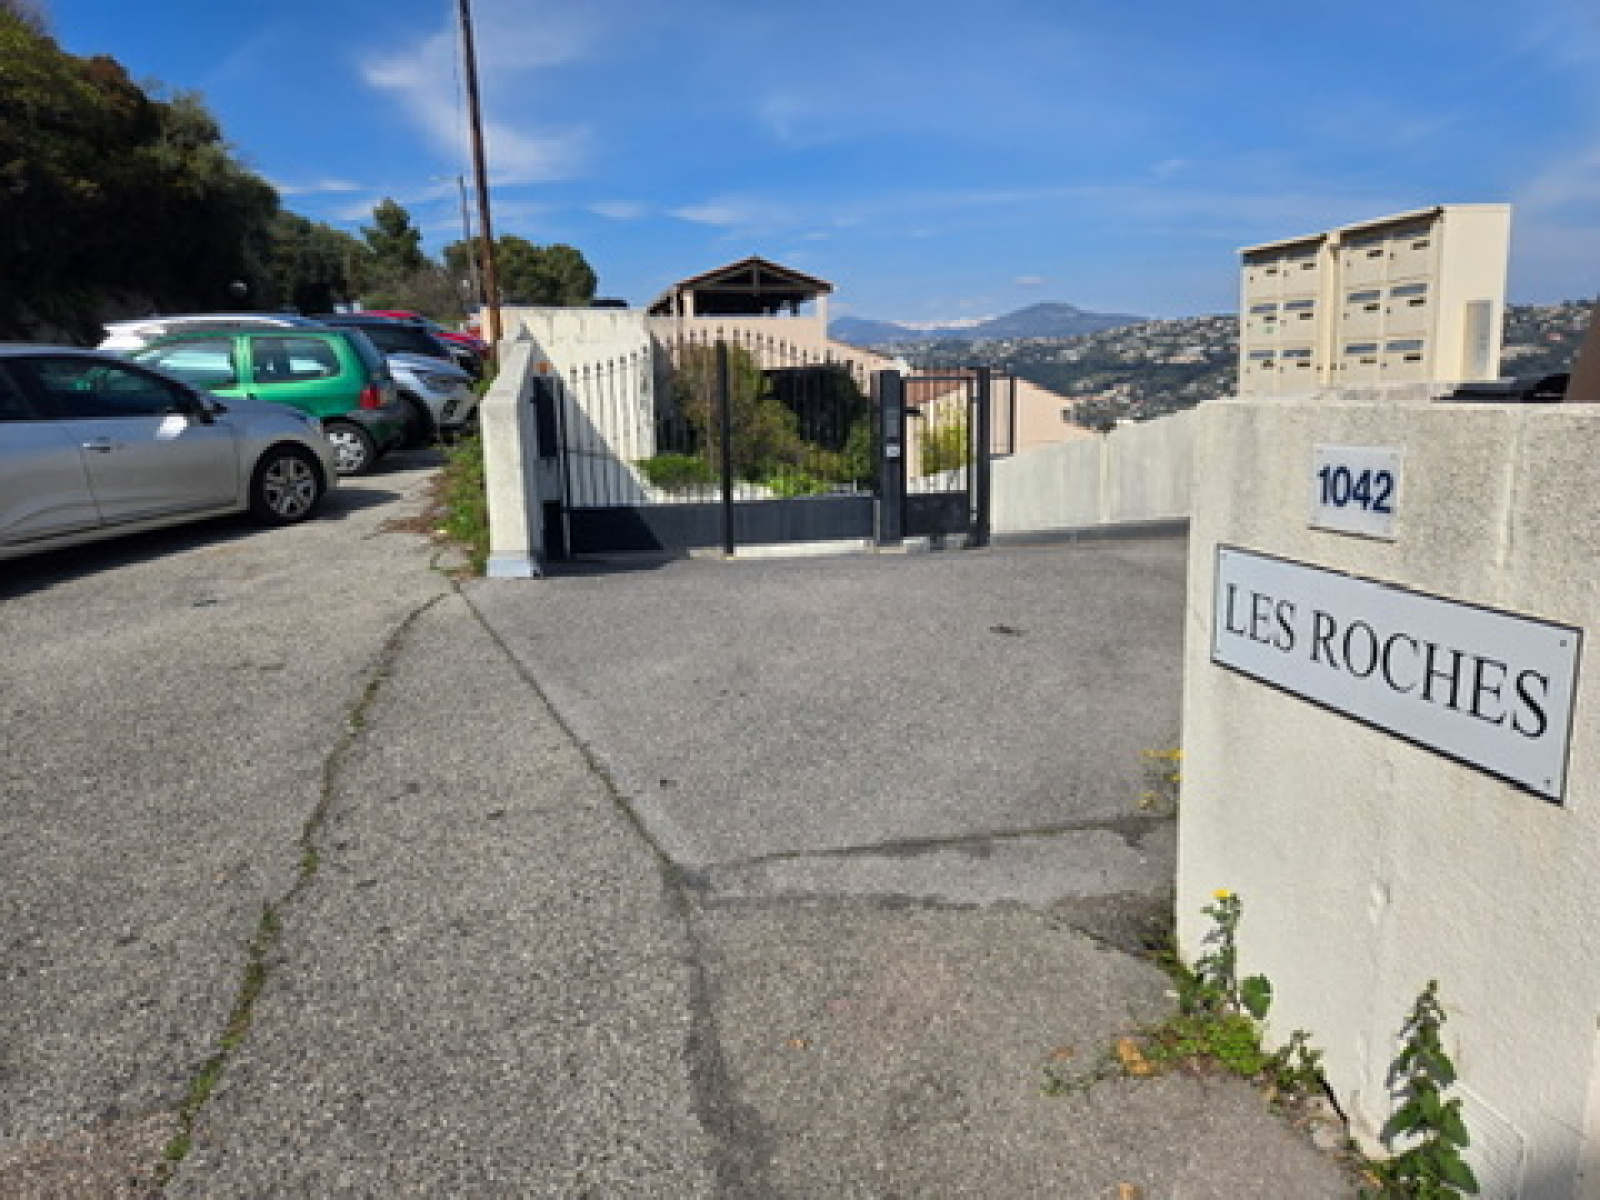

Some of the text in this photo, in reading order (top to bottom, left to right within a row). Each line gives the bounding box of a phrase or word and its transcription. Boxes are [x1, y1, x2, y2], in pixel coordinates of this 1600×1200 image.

[1316, 463, 1395, 515] 1042
[1225, 583, 1549, 739] LES ROCHES
